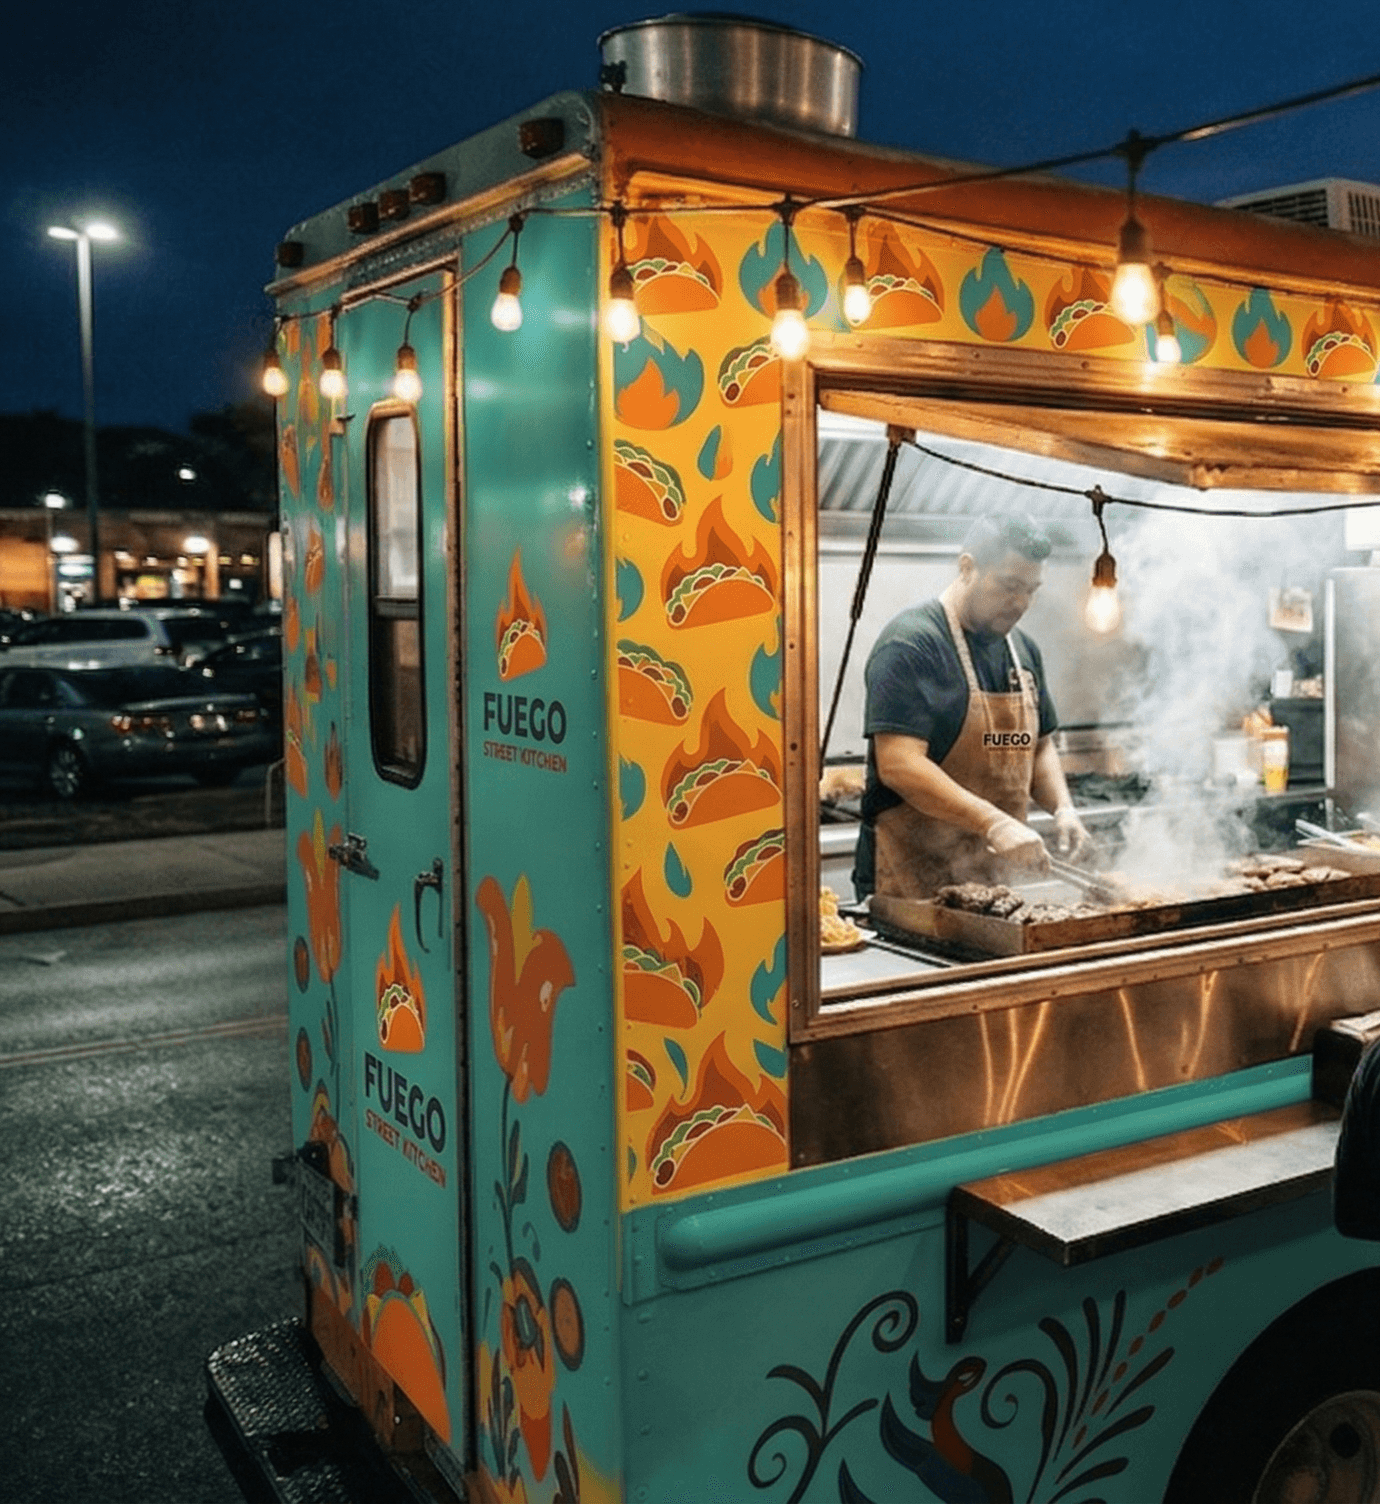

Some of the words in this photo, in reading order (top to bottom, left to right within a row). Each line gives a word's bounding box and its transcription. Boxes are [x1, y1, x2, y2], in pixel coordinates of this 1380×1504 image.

[484, 692, 567, 744] FUEGO
[983, 732, 1031, 746] FUEGO
[365, 1051, 446, 1154] FUEGO
